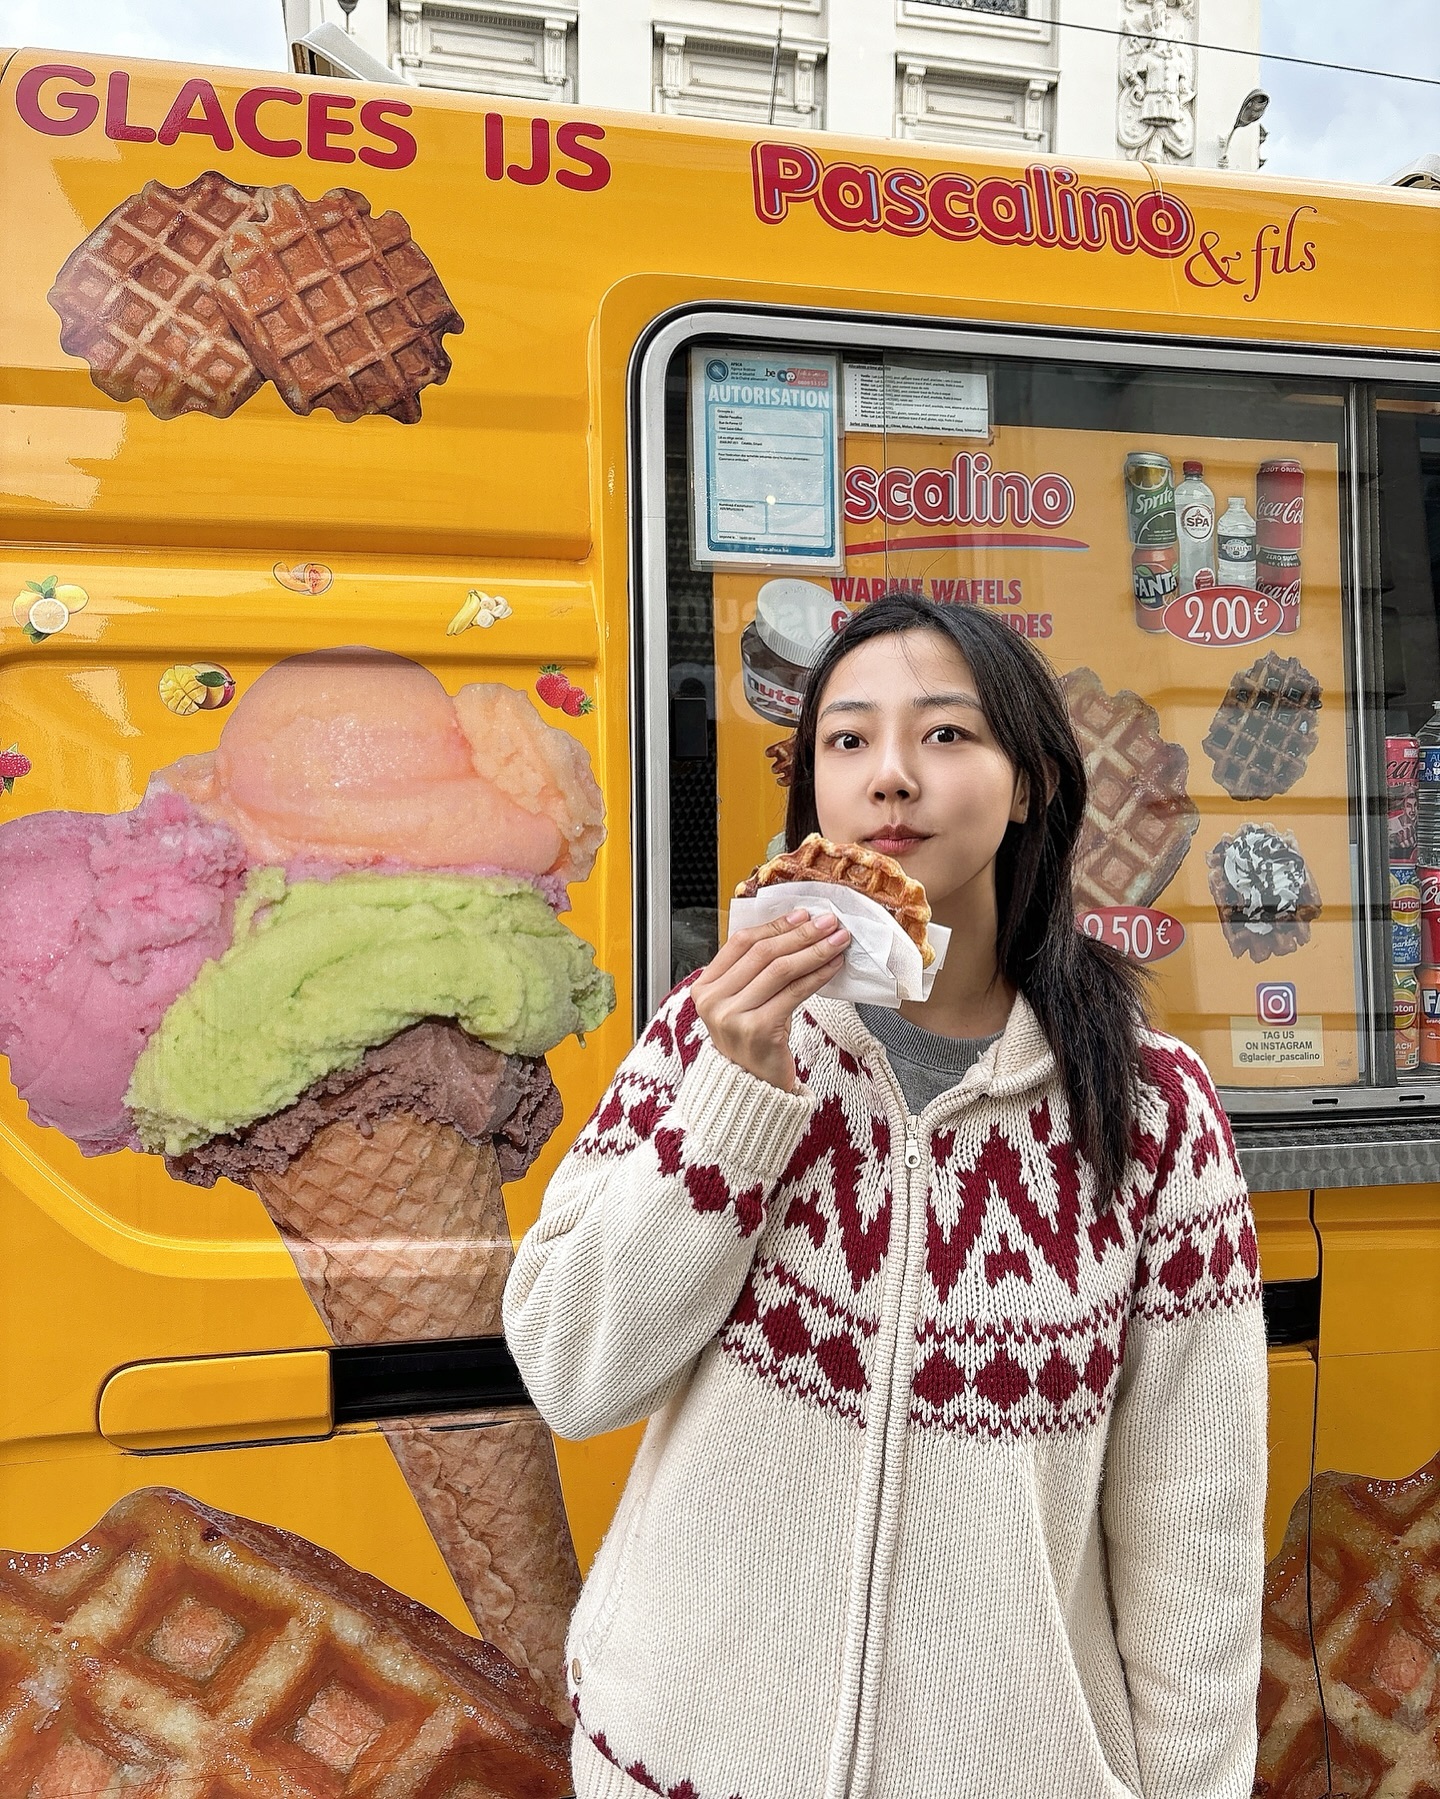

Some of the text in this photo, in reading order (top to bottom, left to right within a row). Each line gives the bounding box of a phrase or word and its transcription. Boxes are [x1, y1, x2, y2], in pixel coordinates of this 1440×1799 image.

[15, 64, 612, 192] GLACES IJS
[751, 140, 1319, 302] Pascalino & fils
[708, 384, 830, 408] AUTORISATION
[1135, 488, 1174, 514] Sprite
[1186, 515, 1210, 528] SPA
[931, 579, 1022, 605] WAFELS
[1134, 572, 1177, 597] FANTA
[1185, 595, 1268, 642] 2,00€
[1392, 900, 1419, 910] Lipton
[1245, 1041, 1313, 1050] ON INSTAGRAM
[1262, 1031, 1295, 1040] TAG US
[1239, 1052, 1320, 1063] @glacier_pascalino
